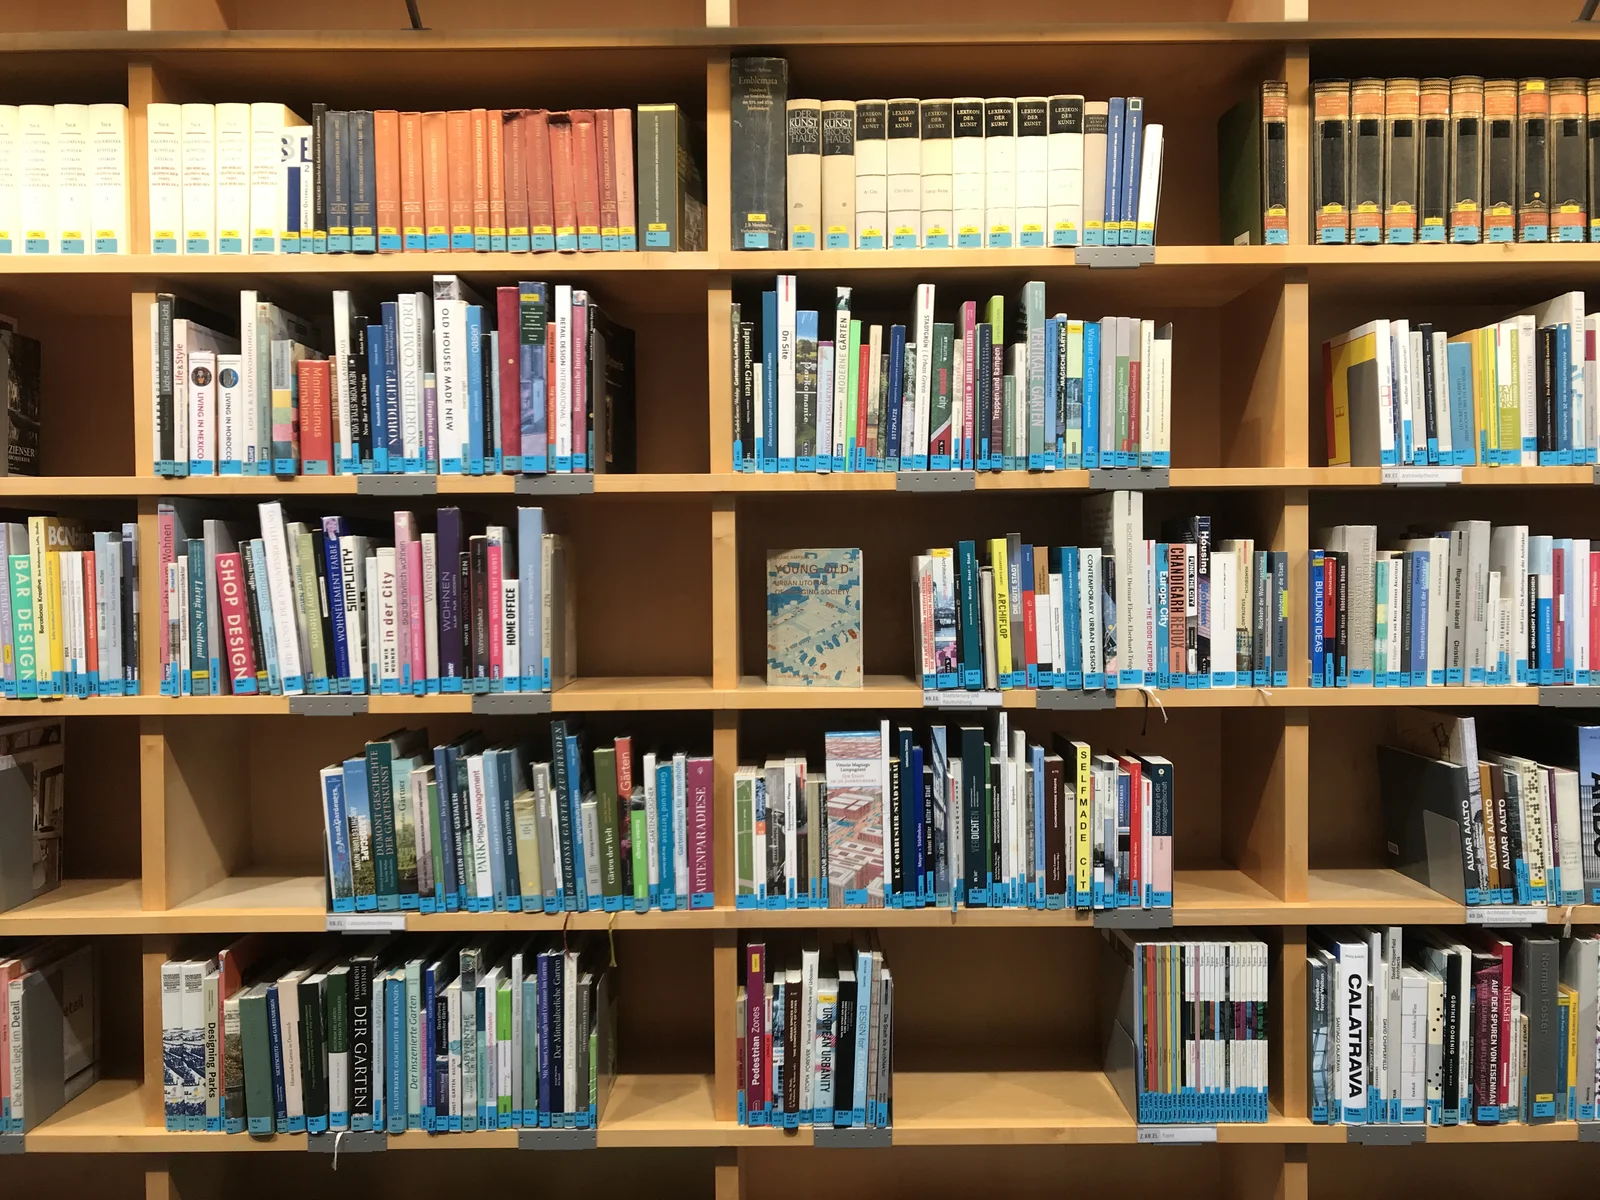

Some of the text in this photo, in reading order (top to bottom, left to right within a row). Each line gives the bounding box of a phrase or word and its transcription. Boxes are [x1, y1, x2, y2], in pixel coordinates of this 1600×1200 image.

[738, 76, 778, 85] Emblemata
[789, 119, 817, 127] KUNST
[789, 127, 818, 136] BROCK
[824, 120, 852, 128] KUNST
[824, 128, 853, 136] BROCK
[743, 328, 753, 396] Japanische Gärten
[782, 331, 789, 341] On
[838, 318, 847, 393] MODERNE GÄRTEN
[992, 348, 1001, 376] Rampen
[1088, 356, 1095, 364] im
[300, 368, 310, 432] Minimalisme
[402, 299, 417, 444] NORTHERN COMFORT
[441, 308, 454, 431] OLD HOUSES MADE NEW
[313, 368, 324, 438] Minimalismus
[993, 393, 1001, 420] Treppen
[426, 435, 434, 460] design
[254, 548, 270, 611] Sommerleben
[342, 549, 357, 611] SIMPLICITY
[424, 539, 434, 602] Wintergärten
[1199, 531, 1209, 574] Housing
[329, 544, 345, 642] WOHNELEMENT FARBE
[382, 572, 394, 597] City
[383, 603, 394, 625] der
[998, 593, 1007, 639] ARCHIFLOP
[1158, 571, 1169, 627] Europe City
[1170, 547, 1184, 648] CHANDIGARH REDUX
[14, 560, 34, 680] BAR DESIGN
[194, 580, 205, 658] Living in Scotland
[220, 559, 248, 679] SHOP DESIGN
[505, 588, 516, 646] HOME OFFICE
[1315, 581, 1324, 652] BUILDING IDEAS
[620, 751, 631, 791] Gärten
[674, 762, 683, 796] Innenhöfe
[1080, 751, 1088, 842] SELFMADE
[370, 750, 384, 856] DUMONT GESCHICHTE
[381, 765, 394, 855] DER GARTENKUNST
[1154, 799, 1162, 834] Stadtplanung
[1160, 781, 1168, 834] Wissensgesellschaft
[1485, 799, 1498, 869] ALVAR AALTO
[1498, 799, 1511, 870] ALVAR AALTO
[452, 793, 465, 884] GARTEN RÄUME GESTALTEN
[604, 827, 615, 884] Gärten der Welt
[1461, 800, 1475, 871] ALVAR AALTO
[409, 995, 417, 1025] Garten
[859, 1005, 867, 1036] DESIGN
[1540, 952, 1550, 1033] Norman Foster
[10, 1000, 23, 1107] Die Kunst liegt im Detail
[206, 1022, 217, 1098] Designing Parks
[354, 1005, 367, 1108] DER GARTEN
[751, 1006, 761, 1085] Pedestrian Zones
[820, 1007, 832, 1093] UROPEAN URBANITY
[1348, 973, 1362, 1098] CALATRAVA
[856, 1050, 865, 1092] FLOODING
[1489, 1063, 1497, 1105] EISENMAN
